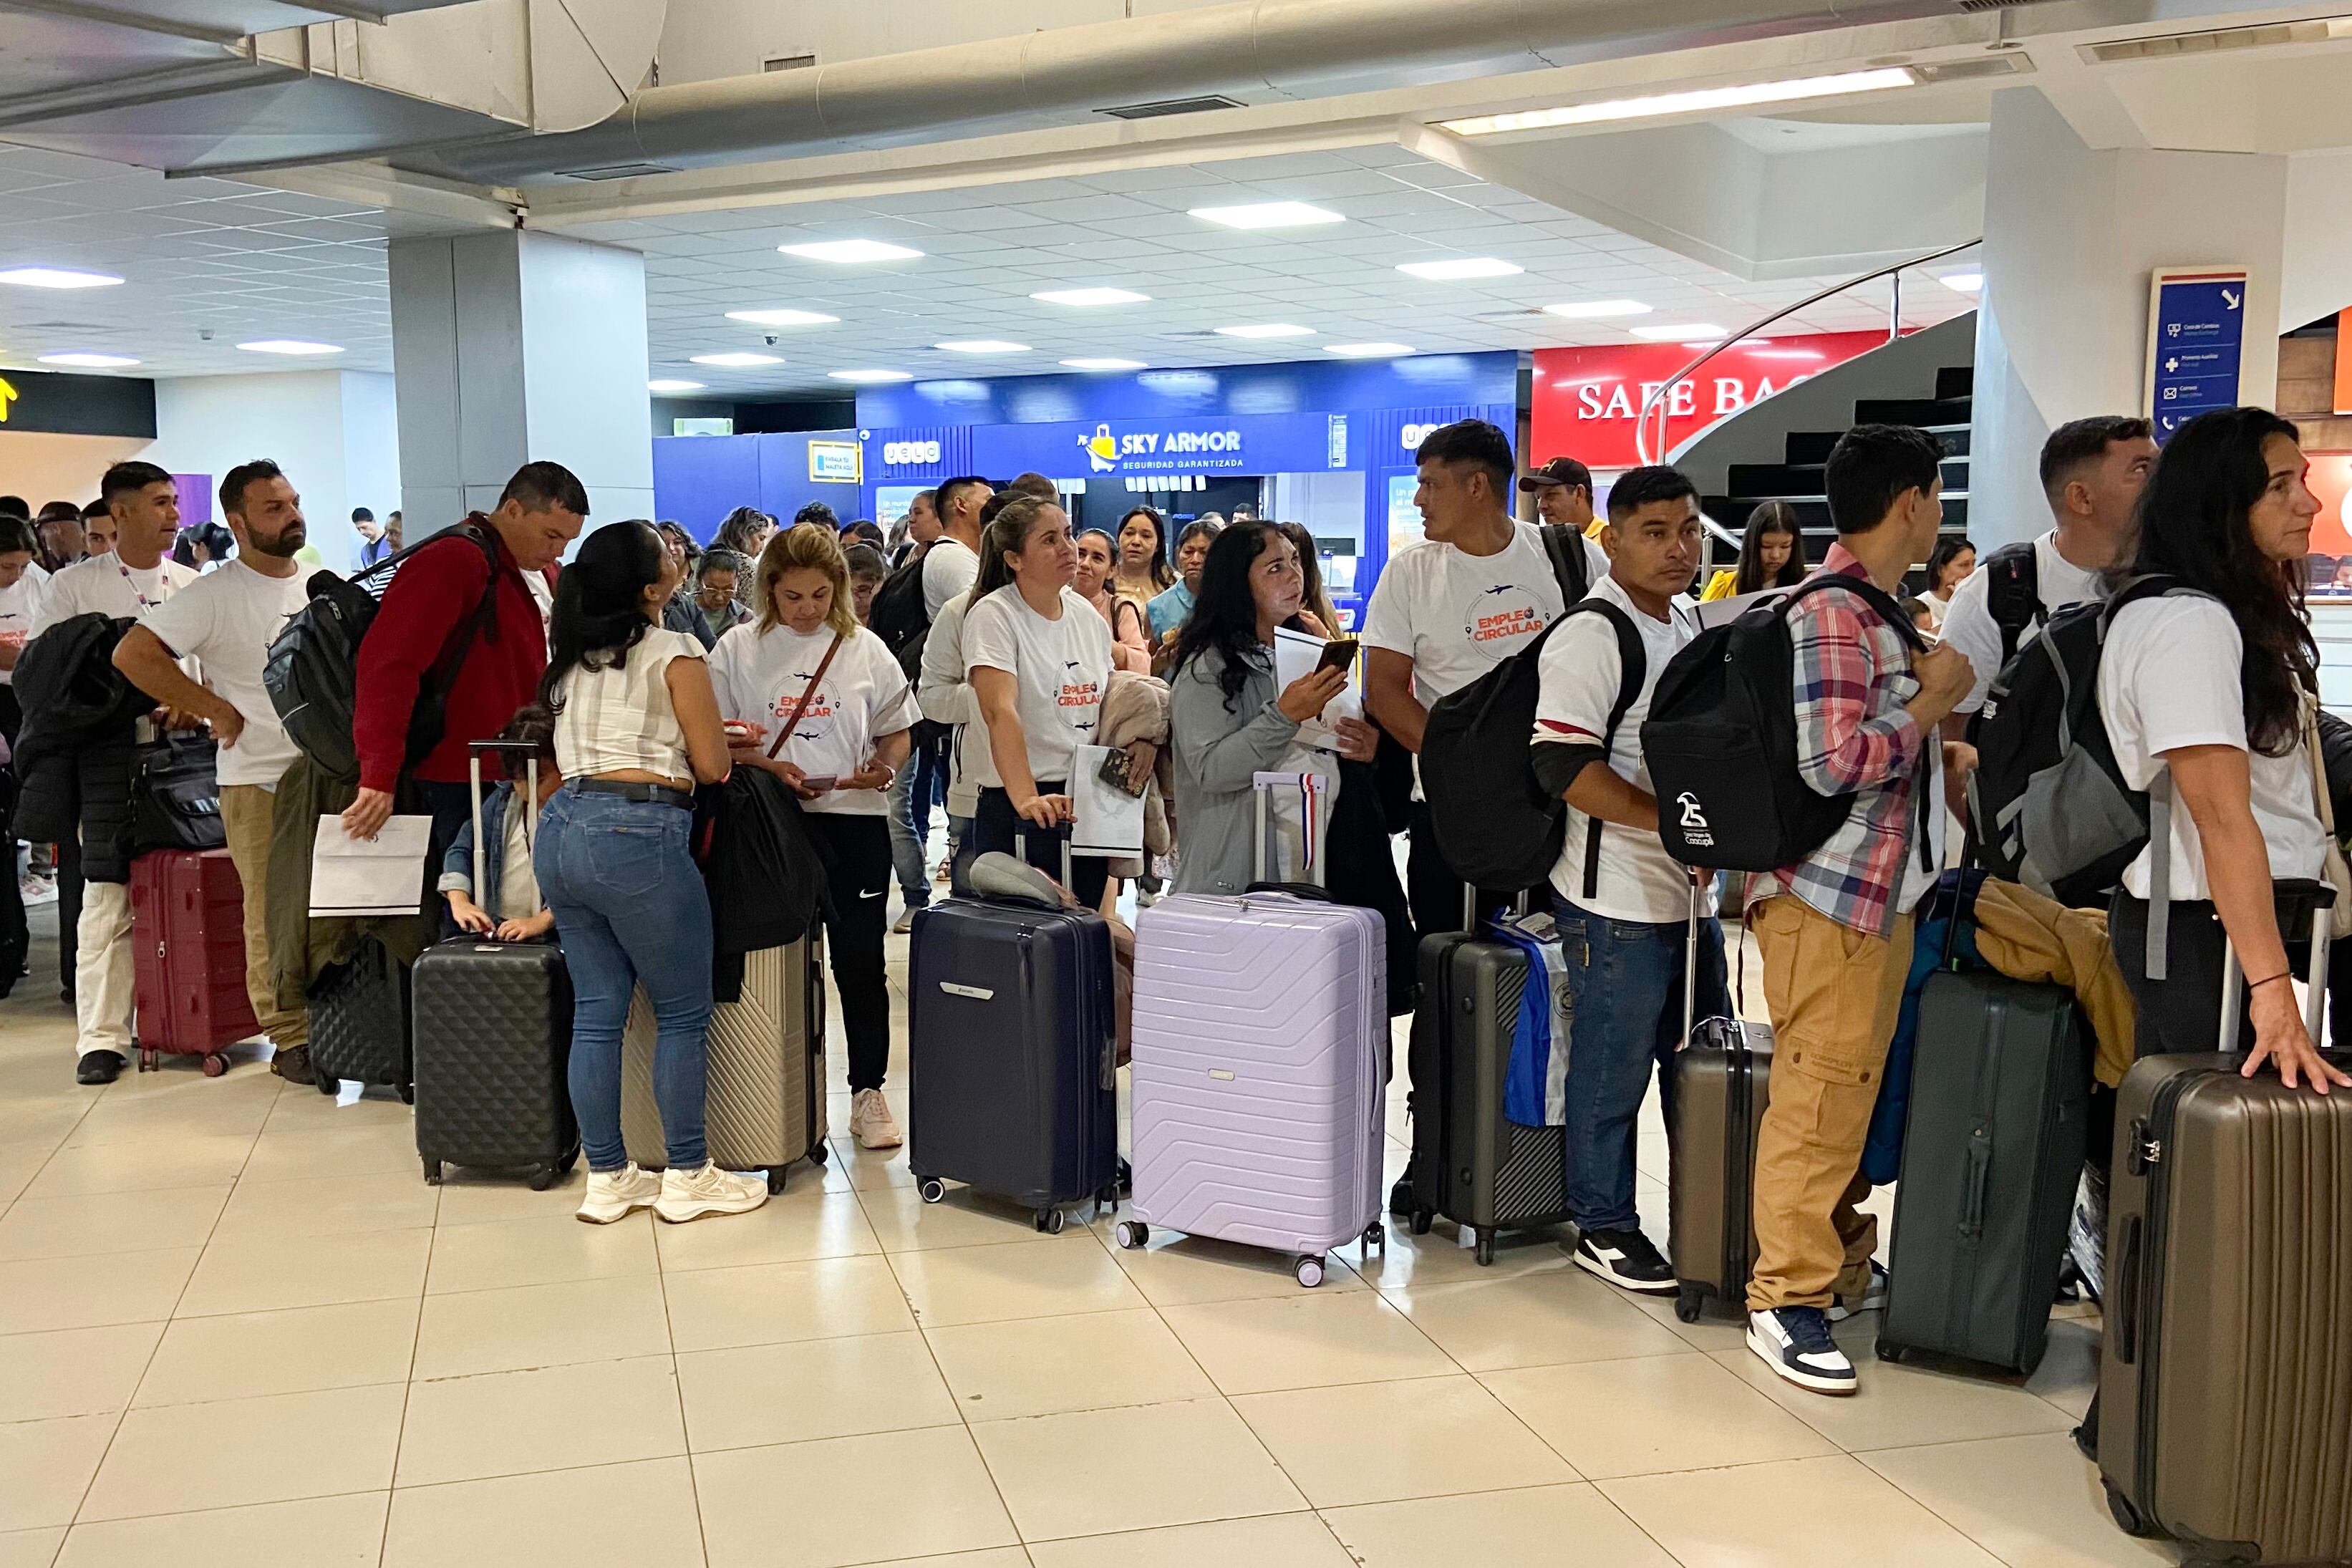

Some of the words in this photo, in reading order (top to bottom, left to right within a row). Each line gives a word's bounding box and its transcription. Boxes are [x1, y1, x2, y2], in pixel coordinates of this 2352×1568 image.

[1577, 379, 1697, 420] SAFE
[1713, 374, 1809, 415] BA
[1121, 433, 1160, 454] SKY
[1163, 431, 1242, 453] ARMOR
[1123, 461, 1174, 470] SEGURIDAD
[1177, 459, 1244, 469] GARANTIZADA
[1473, 620, 1544, 642] CIRCULAR
[1677, 793, 1708, 828] 25
